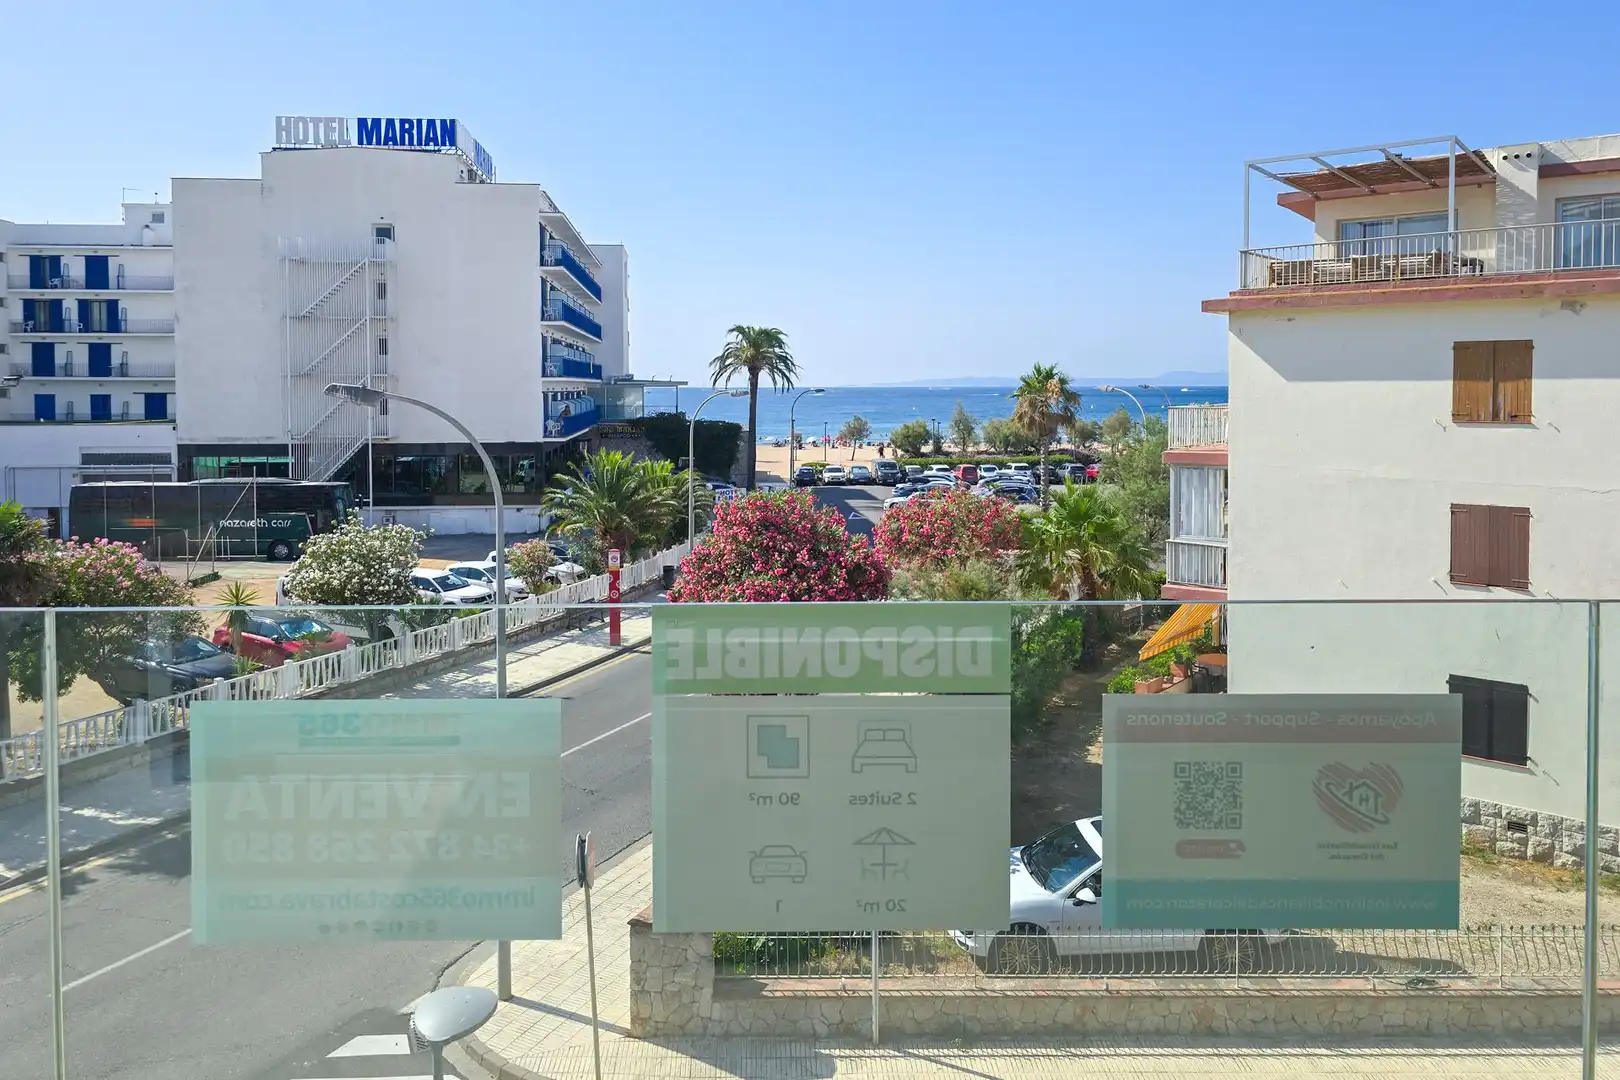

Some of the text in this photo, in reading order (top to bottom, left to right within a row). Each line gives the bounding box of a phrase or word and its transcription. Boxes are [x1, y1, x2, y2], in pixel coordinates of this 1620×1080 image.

[275, 115, 456, 147] HOTEL MARIAN
[219, 517, 292, 528] nazareth cars
